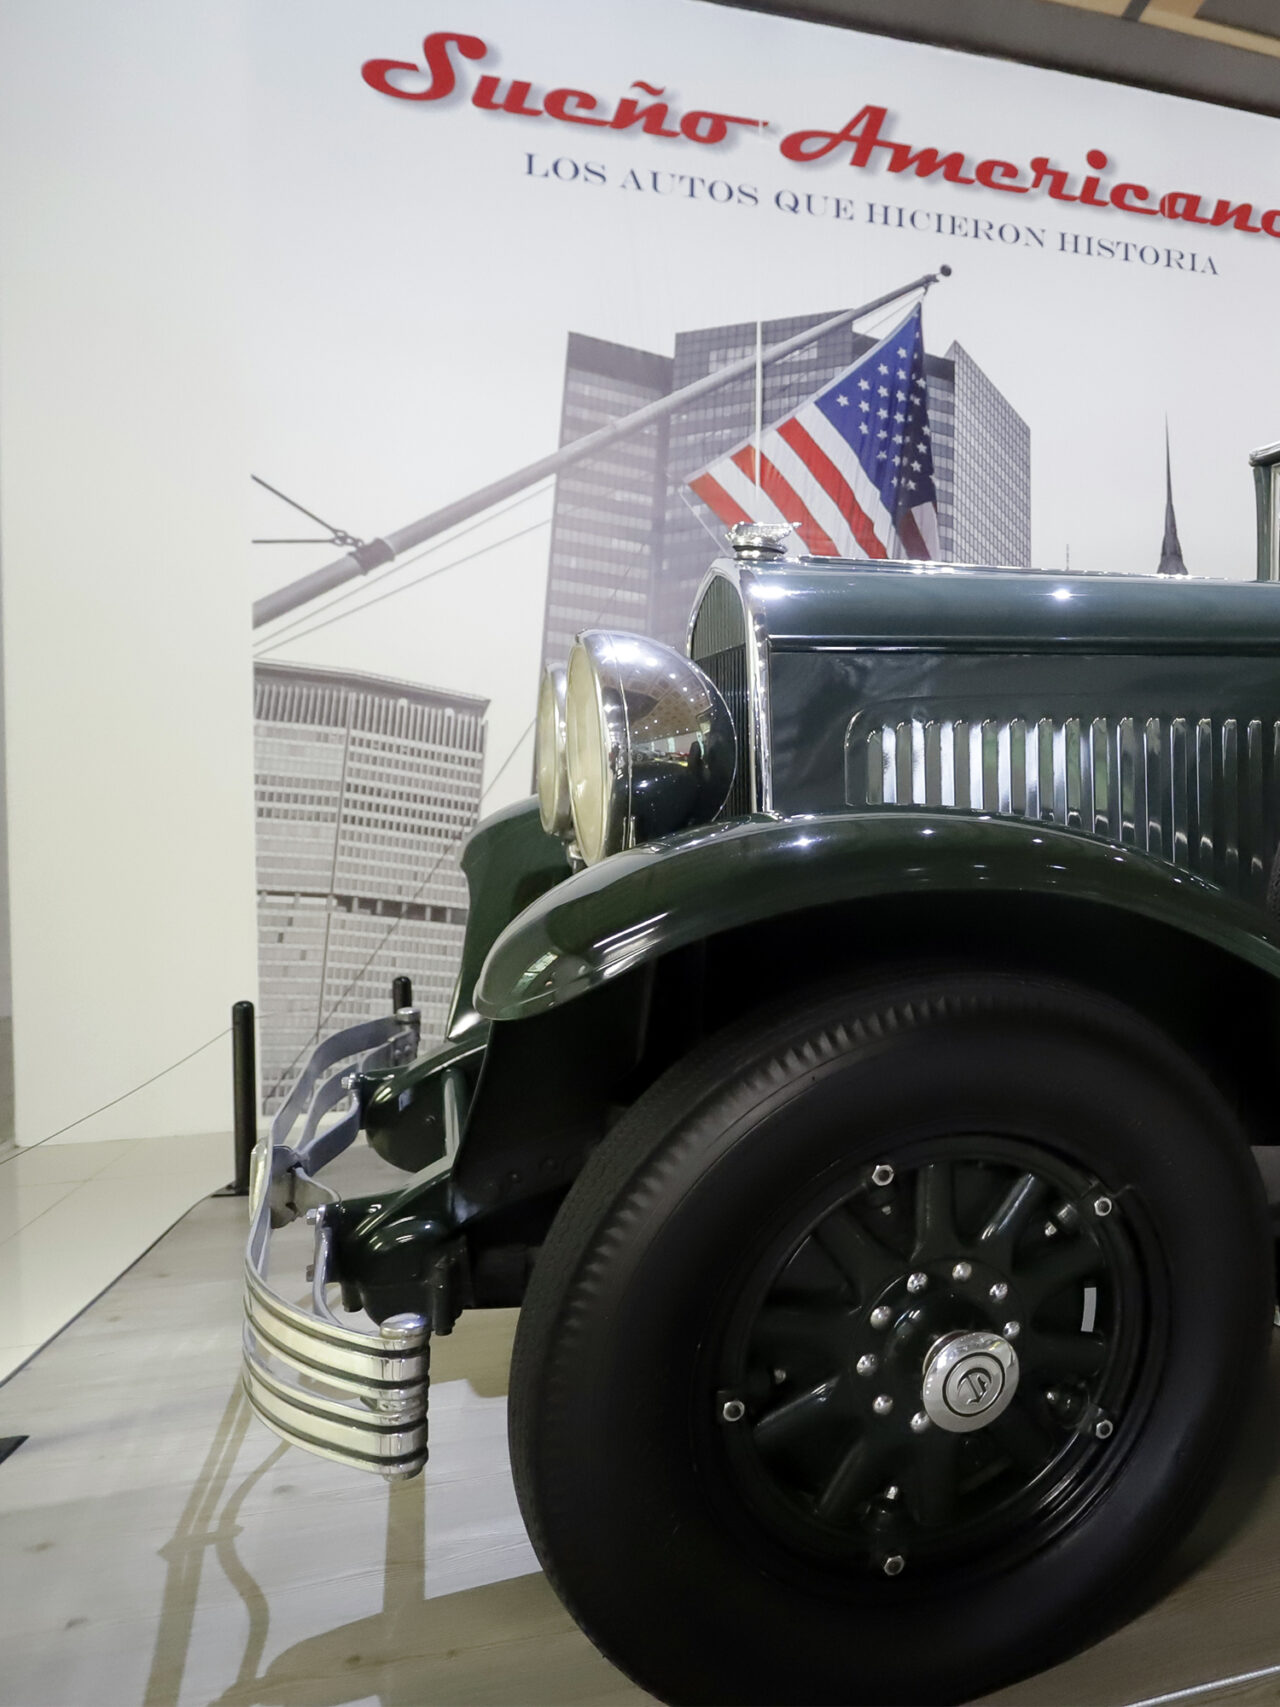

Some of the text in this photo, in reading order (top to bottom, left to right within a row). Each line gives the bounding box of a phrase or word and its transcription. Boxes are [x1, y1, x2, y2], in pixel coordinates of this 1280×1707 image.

[361, 32, 769, 145] Sueño
[525, 152, 1220, 276] LOS AUTOS QUE HICIERON HISTORIA
